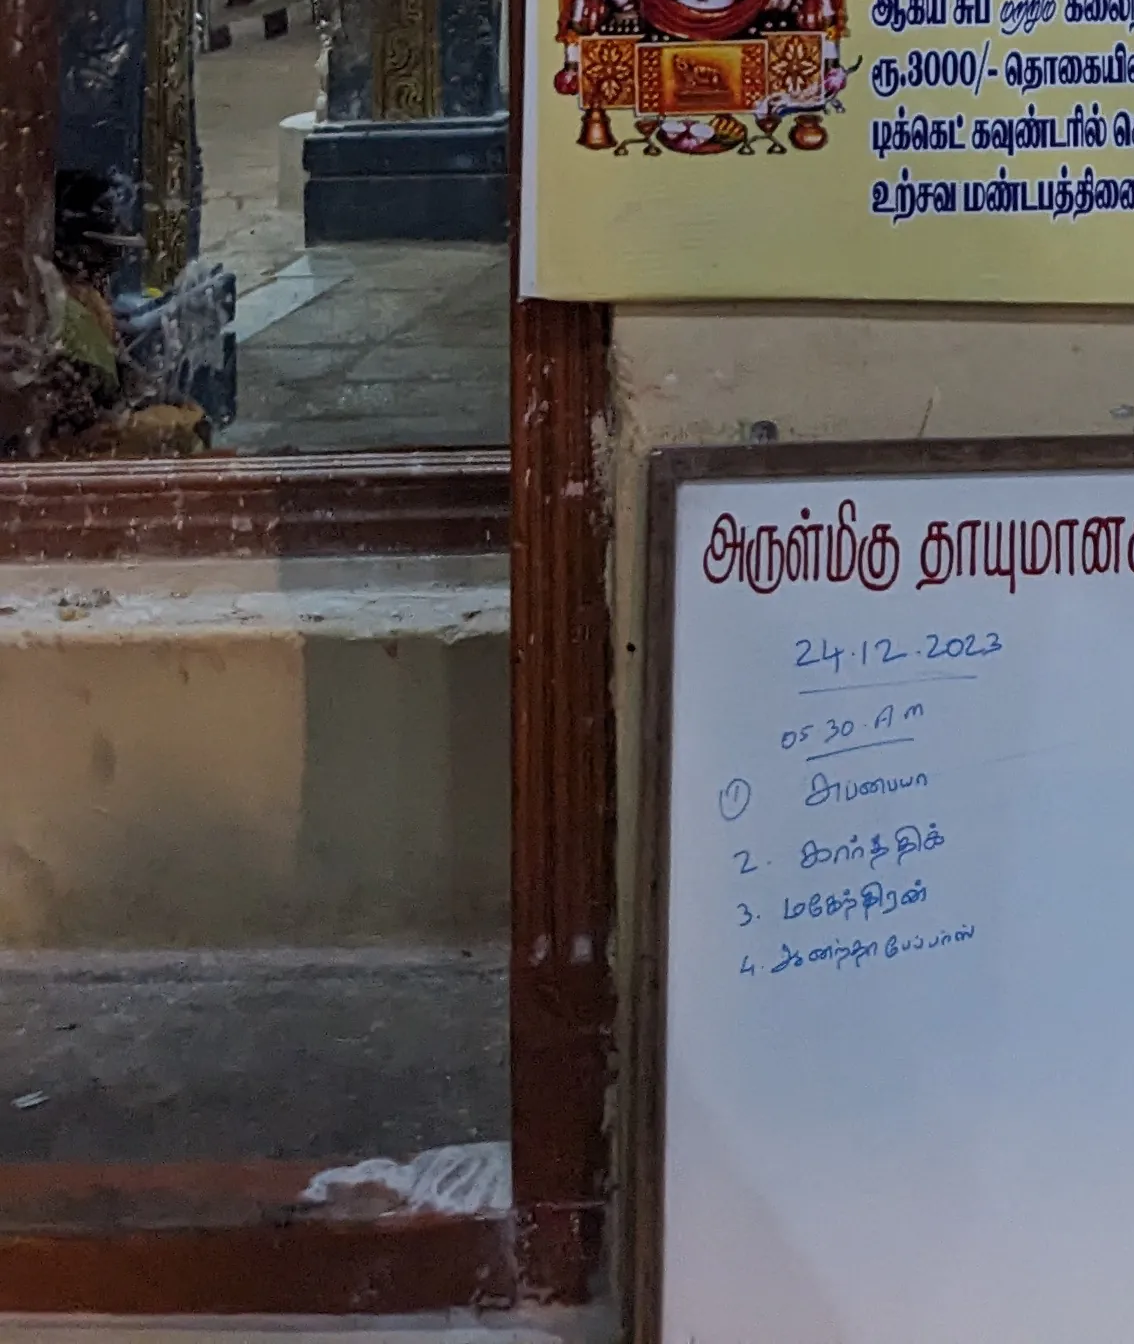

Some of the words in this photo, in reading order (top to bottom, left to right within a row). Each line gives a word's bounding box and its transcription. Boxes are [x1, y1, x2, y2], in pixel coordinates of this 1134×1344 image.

[872, 41, 997, 96] ரூ.3000/-
[872, 106, 965, 153] டிக்கெட்
[972, 103, 1107, 154] கவுண்டரில்
[872, 168, 955, 221] உற்சவ
[704, 499, 899, 592] அருள்மிகு
[795, 632, 1003, 673] 24.12.2023
[733, 849, 771, 875] 2.
[737, 902, 762, 927] 3.
